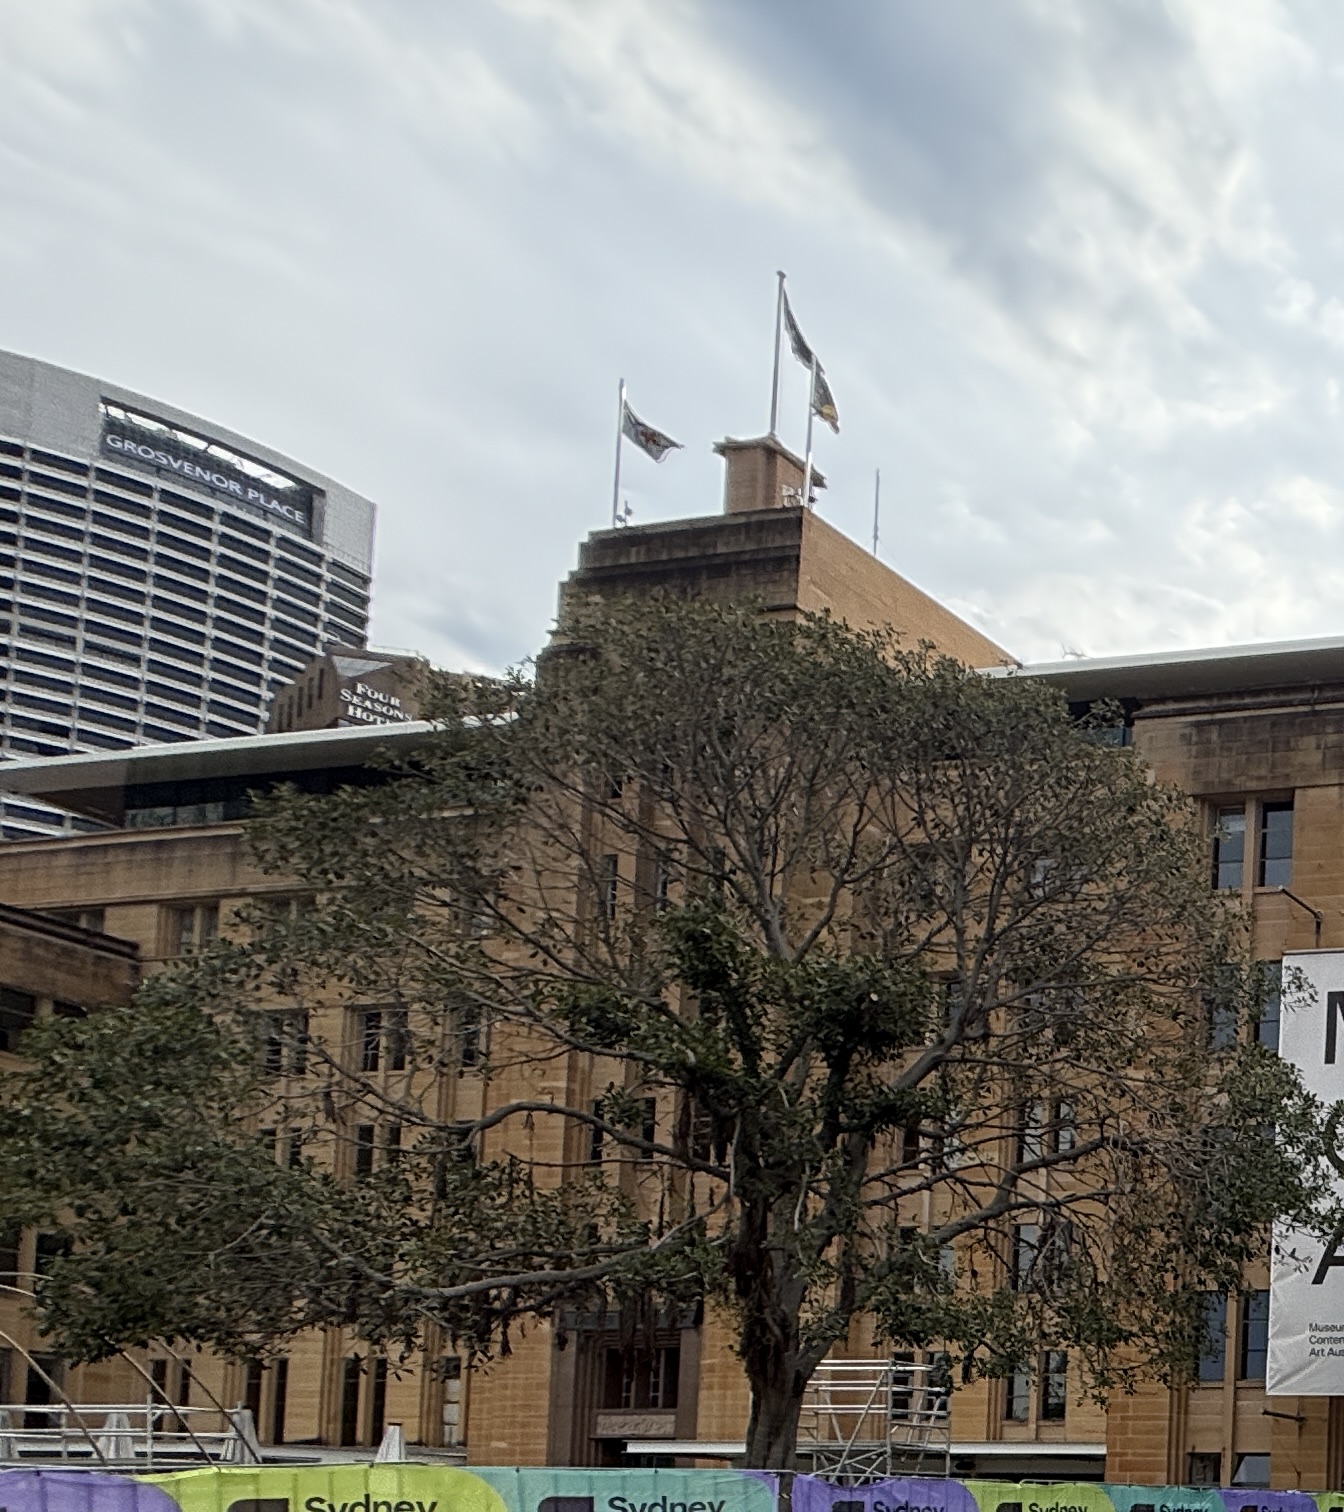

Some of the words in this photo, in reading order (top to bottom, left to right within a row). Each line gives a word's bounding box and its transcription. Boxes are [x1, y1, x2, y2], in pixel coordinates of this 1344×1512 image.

[105, 434, 244, 496] GROSVENOR
[247, 487, 305, 524] PLACE
[1308, 1347, 1326, 1358] Art
